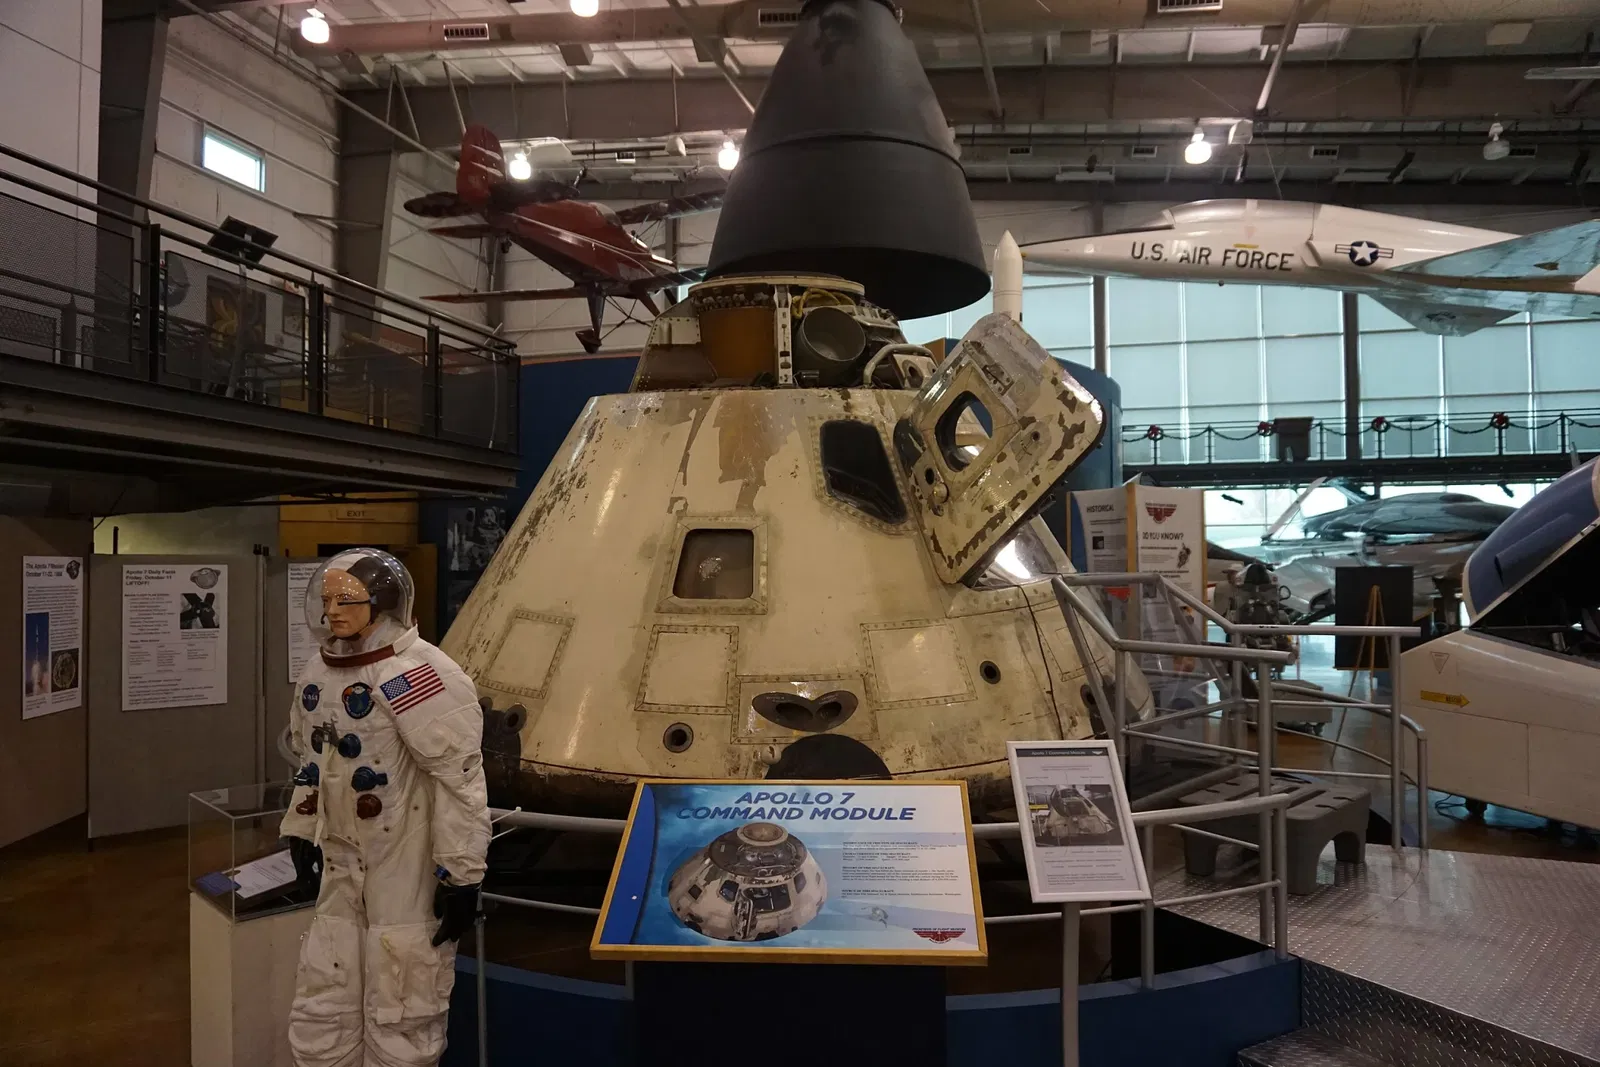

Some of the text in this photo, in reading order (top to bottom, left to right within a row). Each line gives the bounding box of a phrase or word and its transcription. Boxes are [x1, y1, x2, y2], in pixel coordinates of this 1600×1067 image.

[1131, 241, 1294, 271] U.S. AIR FORCE
[1086, 504, 1114, 513] HISTORICAL
[1161, 532, 1184, 541] KNOW?
[735, 792, 856, 805] APOLLO 7
[676, 807, 916, 820] COMMAND MODULE
